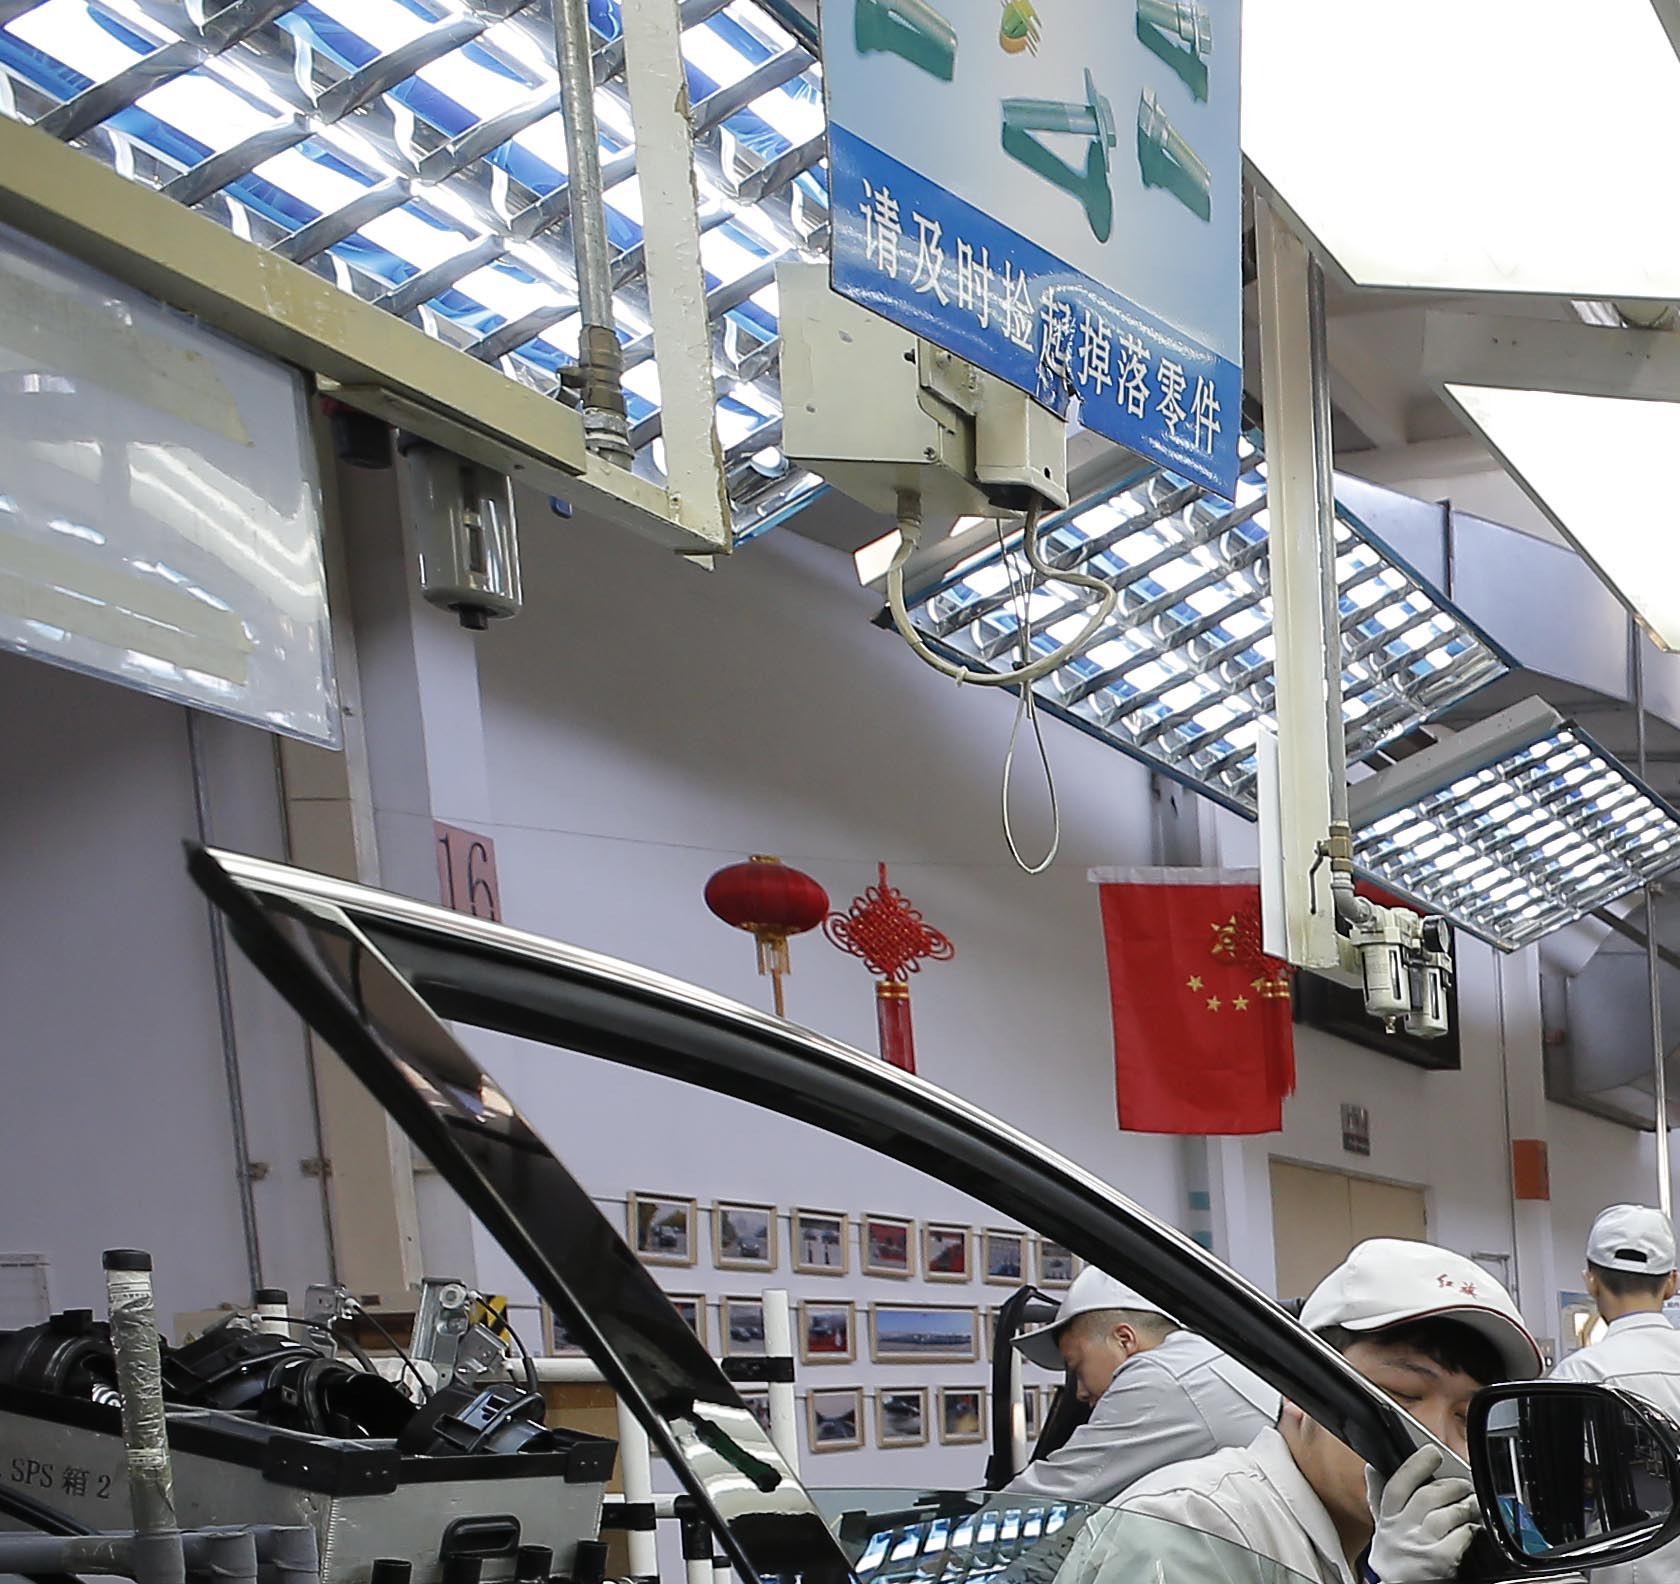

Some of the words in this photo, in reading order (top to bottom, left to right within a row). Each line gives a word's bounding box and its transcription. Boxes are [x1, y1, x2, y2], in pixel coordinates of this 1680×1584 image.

[860, 178, 1222, 456] 请及时捡起掉落零件
[11, 1458, 54, 1488] SPS
[62, 1465, 90, 1497] 箱
[96, 1474, 112, 1500] 2
